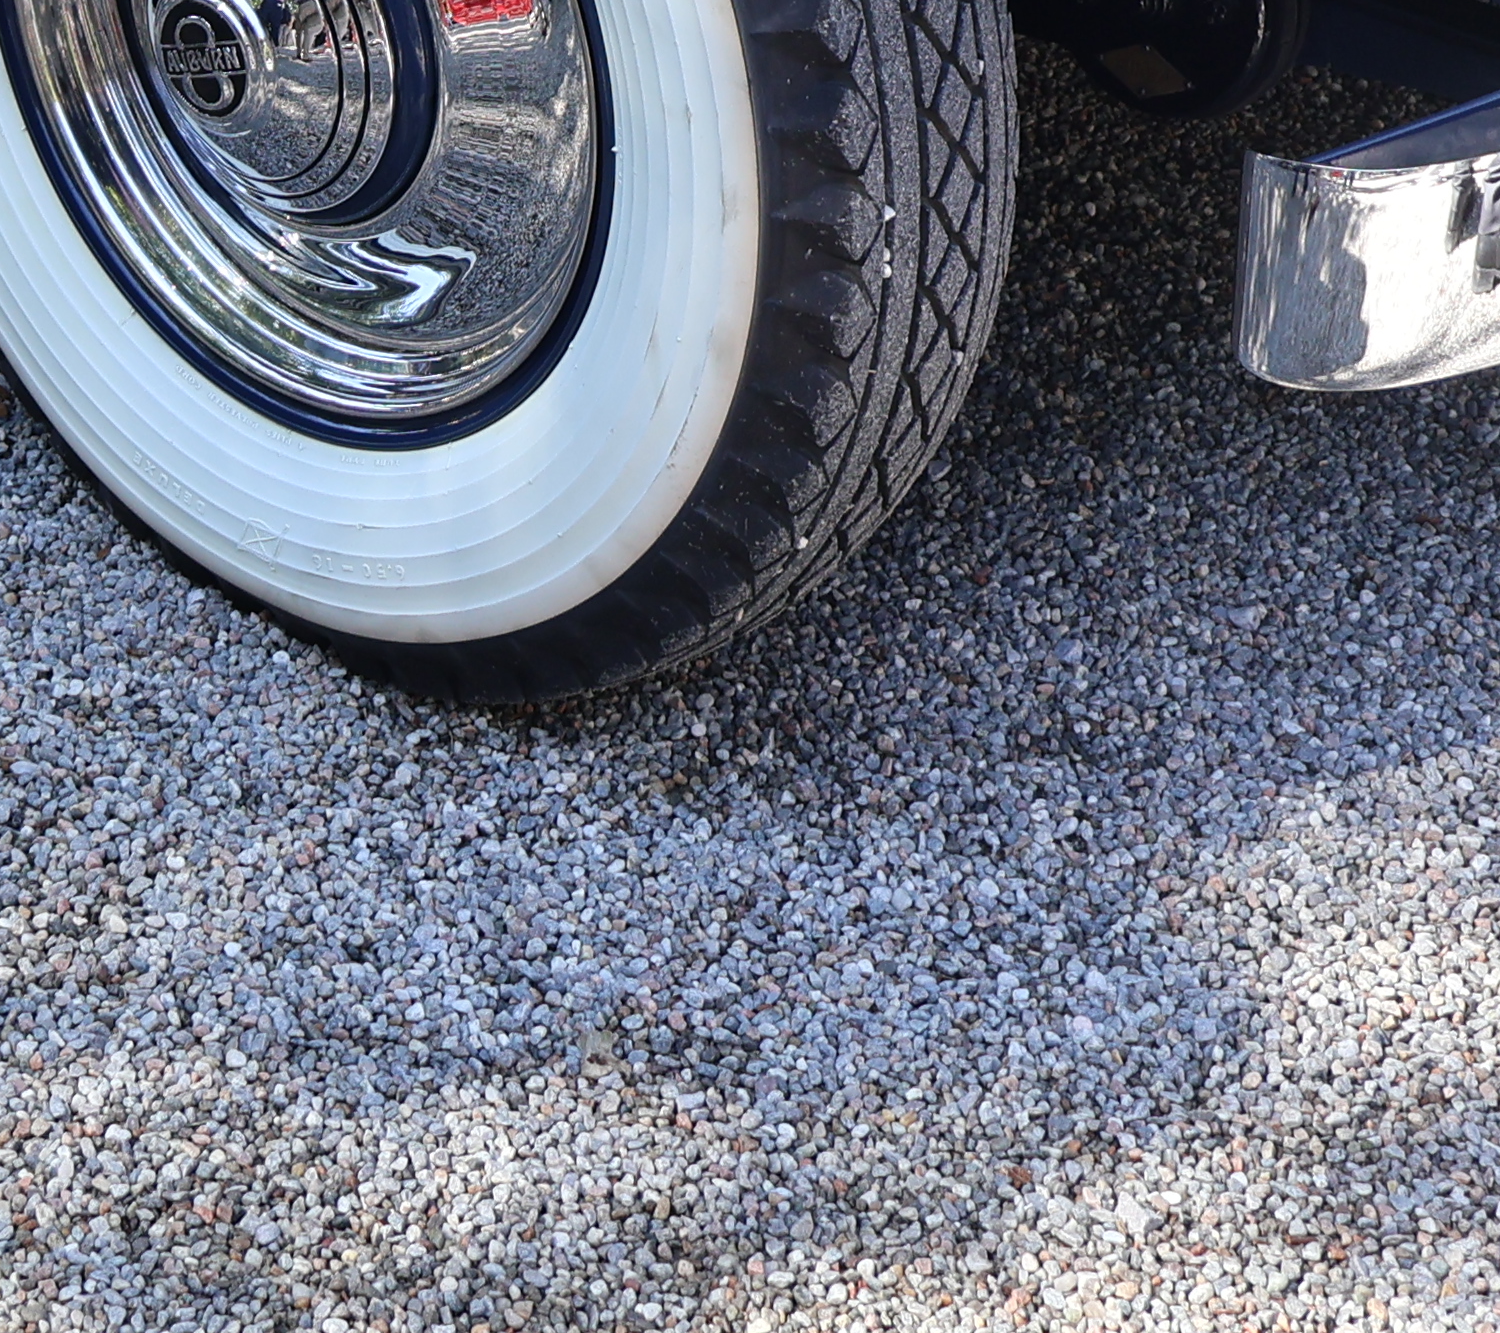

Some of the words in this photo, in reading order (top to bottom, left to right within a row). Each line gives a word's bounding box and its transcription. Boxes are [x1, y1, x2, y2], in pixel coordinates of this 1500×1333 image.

[167, 46, 241, 72] AUBURN
[175, 364, 203, 390] CORD
[206, 391, 259, 430] POLYESTER
[265, 429, 293, 446] PLIES
[131, 451, 206, 515] DELUXE
